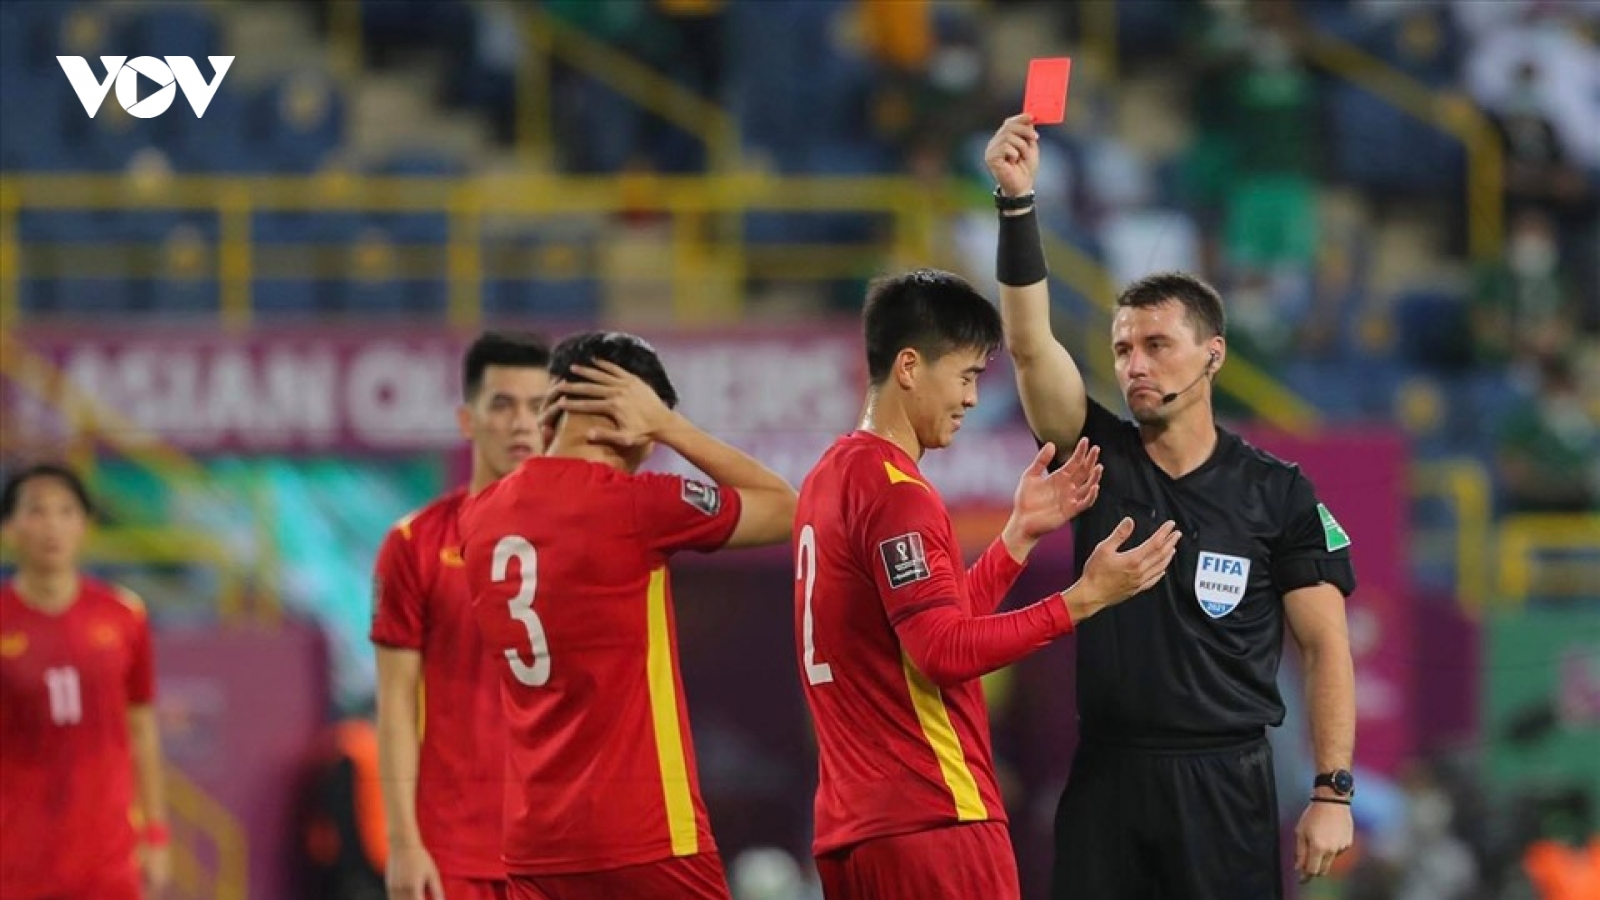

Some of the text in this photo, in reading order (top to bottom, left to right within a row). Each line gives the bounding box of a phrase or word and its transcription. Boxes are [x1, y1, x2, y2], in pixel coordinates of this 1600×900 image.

[1199, 580, 1240, 595] REFEREE
[1202, 556, 1243, 575] FIFA
[491, 535, 550, 687] 3
[796, 524, 833, 686] 2
[44, 667, 82, 727] 11
